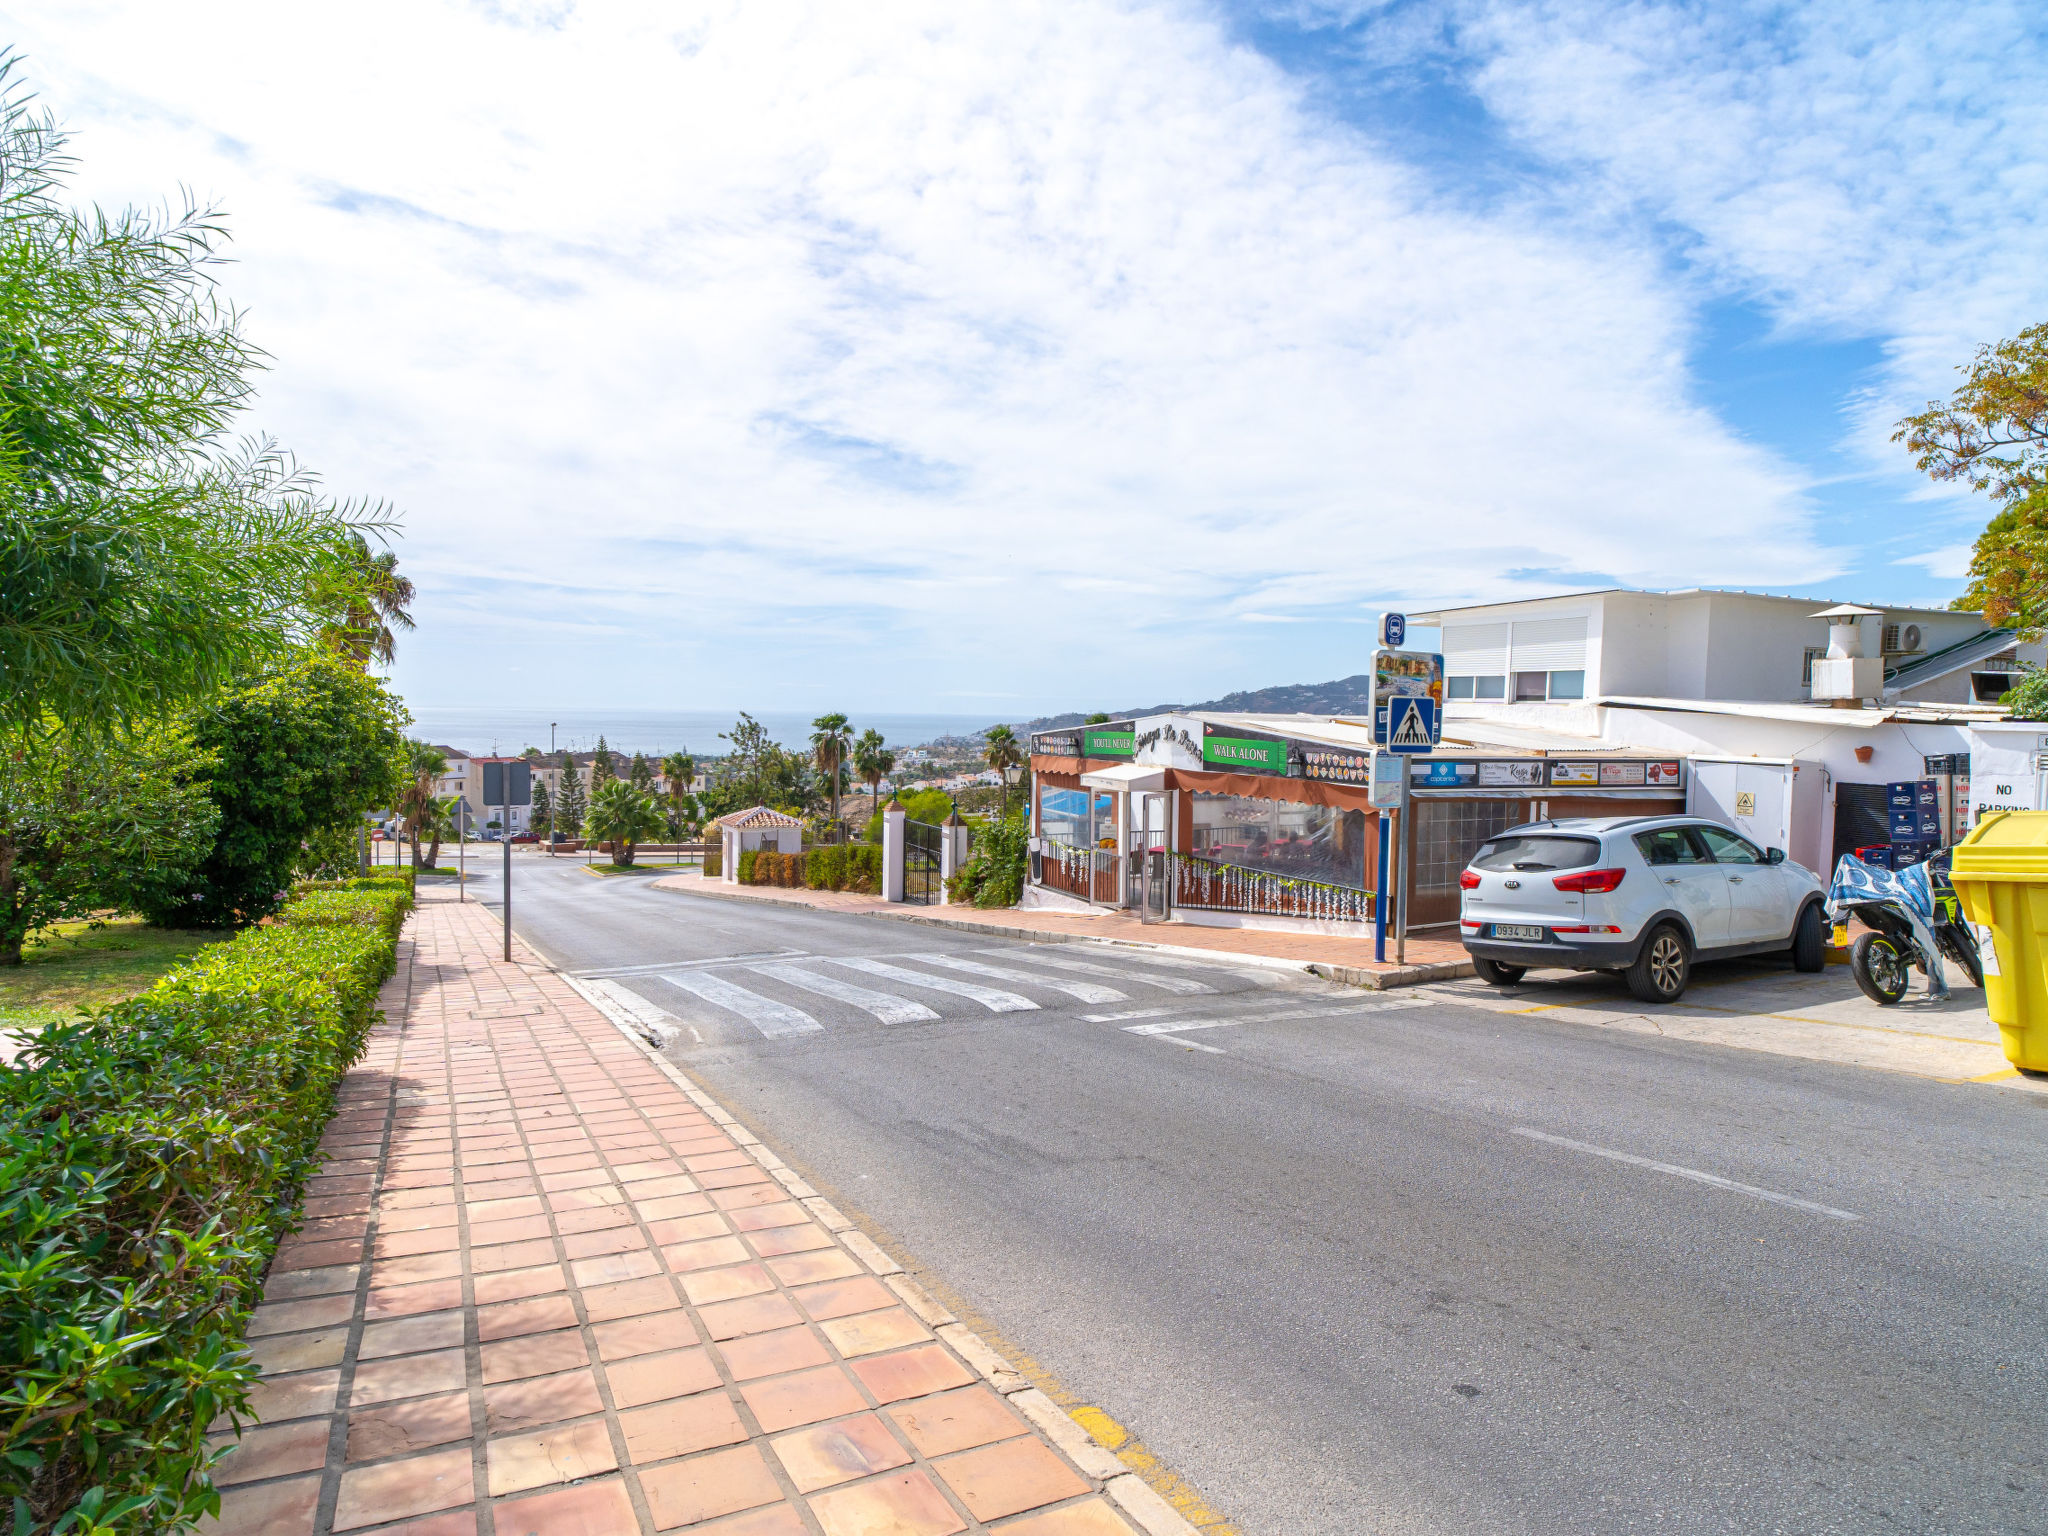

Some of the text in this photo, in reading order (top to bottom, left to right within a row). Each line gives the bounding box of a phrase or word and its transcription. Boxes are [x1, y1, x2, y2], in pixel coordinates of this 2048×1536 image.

[1389, 637, 1400, 645] BUS
[1093, 738, 1131, 749] YOU'LL NEVER
[1212, 744, 1269, 762] WALK ALONE
[1996, 784, 2012, 795] NO
[1506, 880, 1518, 888] KIA
[1496, 926, 1541, 938] 0934 JLR
